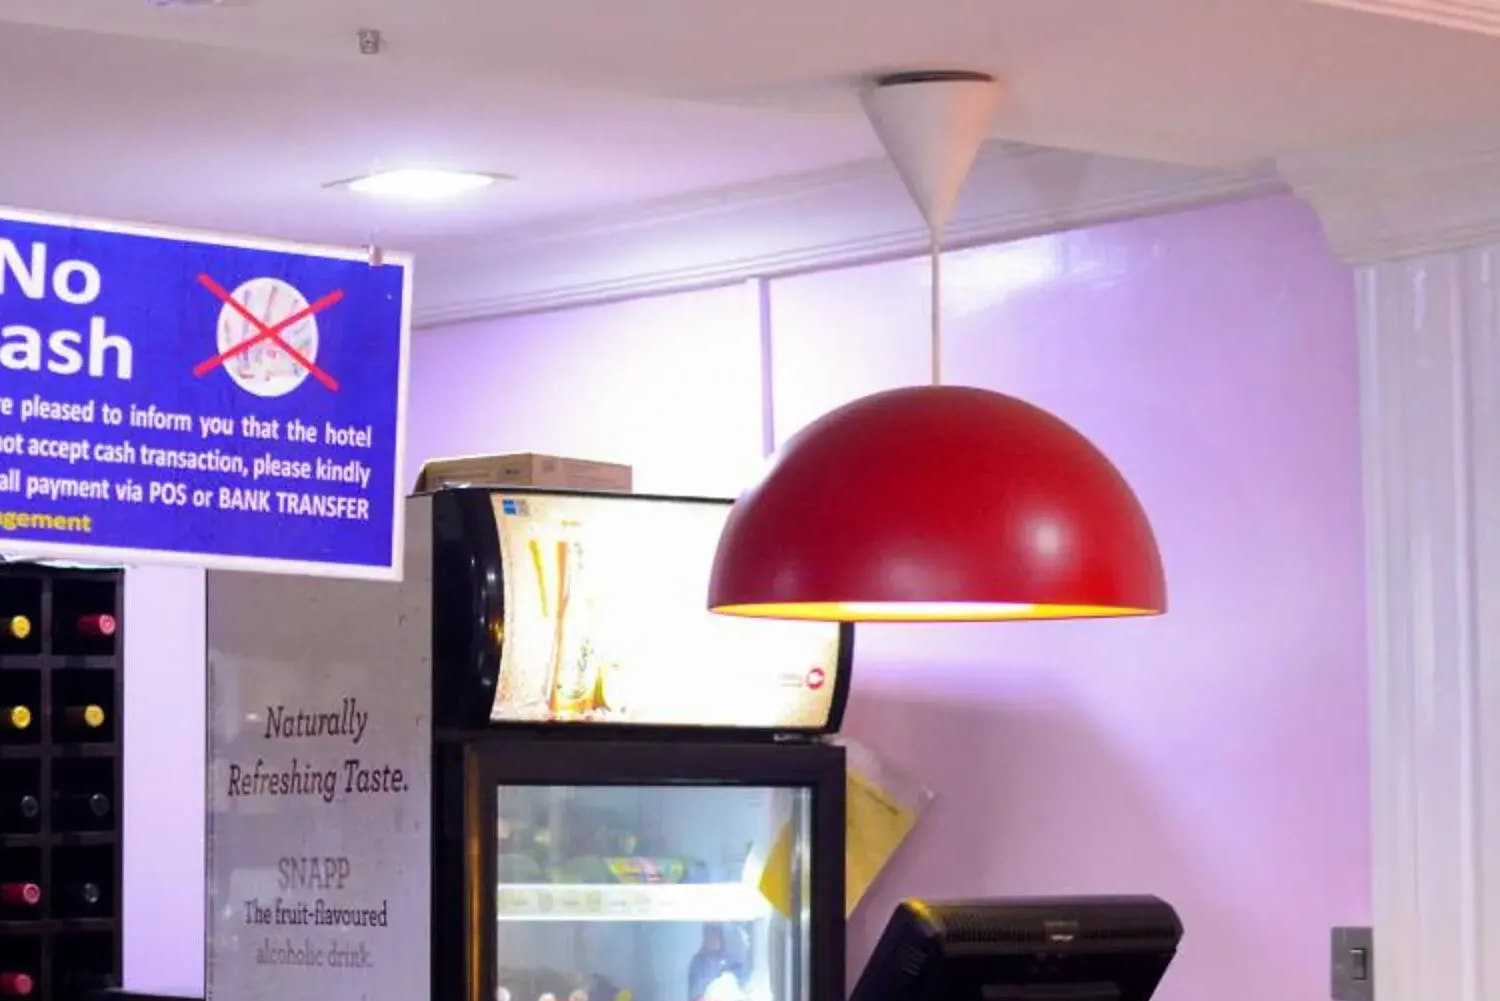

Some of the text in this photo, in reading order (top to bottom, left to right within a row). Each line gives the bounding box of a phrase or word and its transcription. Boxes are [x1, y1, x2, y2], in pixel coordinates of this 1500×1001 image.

[21, 394, 94, 422] pleased
[102, 403, 123, 425] to
[130, 403, 192, 432] inform
[200, 416, 234, 438] you
[242, 415, 279, 440] that
[287, 419, 317, 443] the
[325, 421, 372, 448] hotel
[28, 438, 90, 463] accept
[94, 440, 135, 464] cash
[140, 444, 248, 477] transaction,
[253, 453, 311, 479] please
[316, 457, 371, 488] kindly
[26, 474, 109, 500] payment
[115, 477, 143, 502] via
[150, 481, 187, 506] POS
[193, 489, 213, 508] or
[219, 487, 271, 512] BANK
[276, 491, 370, 520] TRANSFER
[263, 697, 368, 744] Naturally
[227, 757, 409, 803] Refreshing Taste.
[277, 856, 351, 890] SNAPP
[244, 898, 389, 927] The fruit-flavoured
[256, 937, 324, 967] alcoholic
